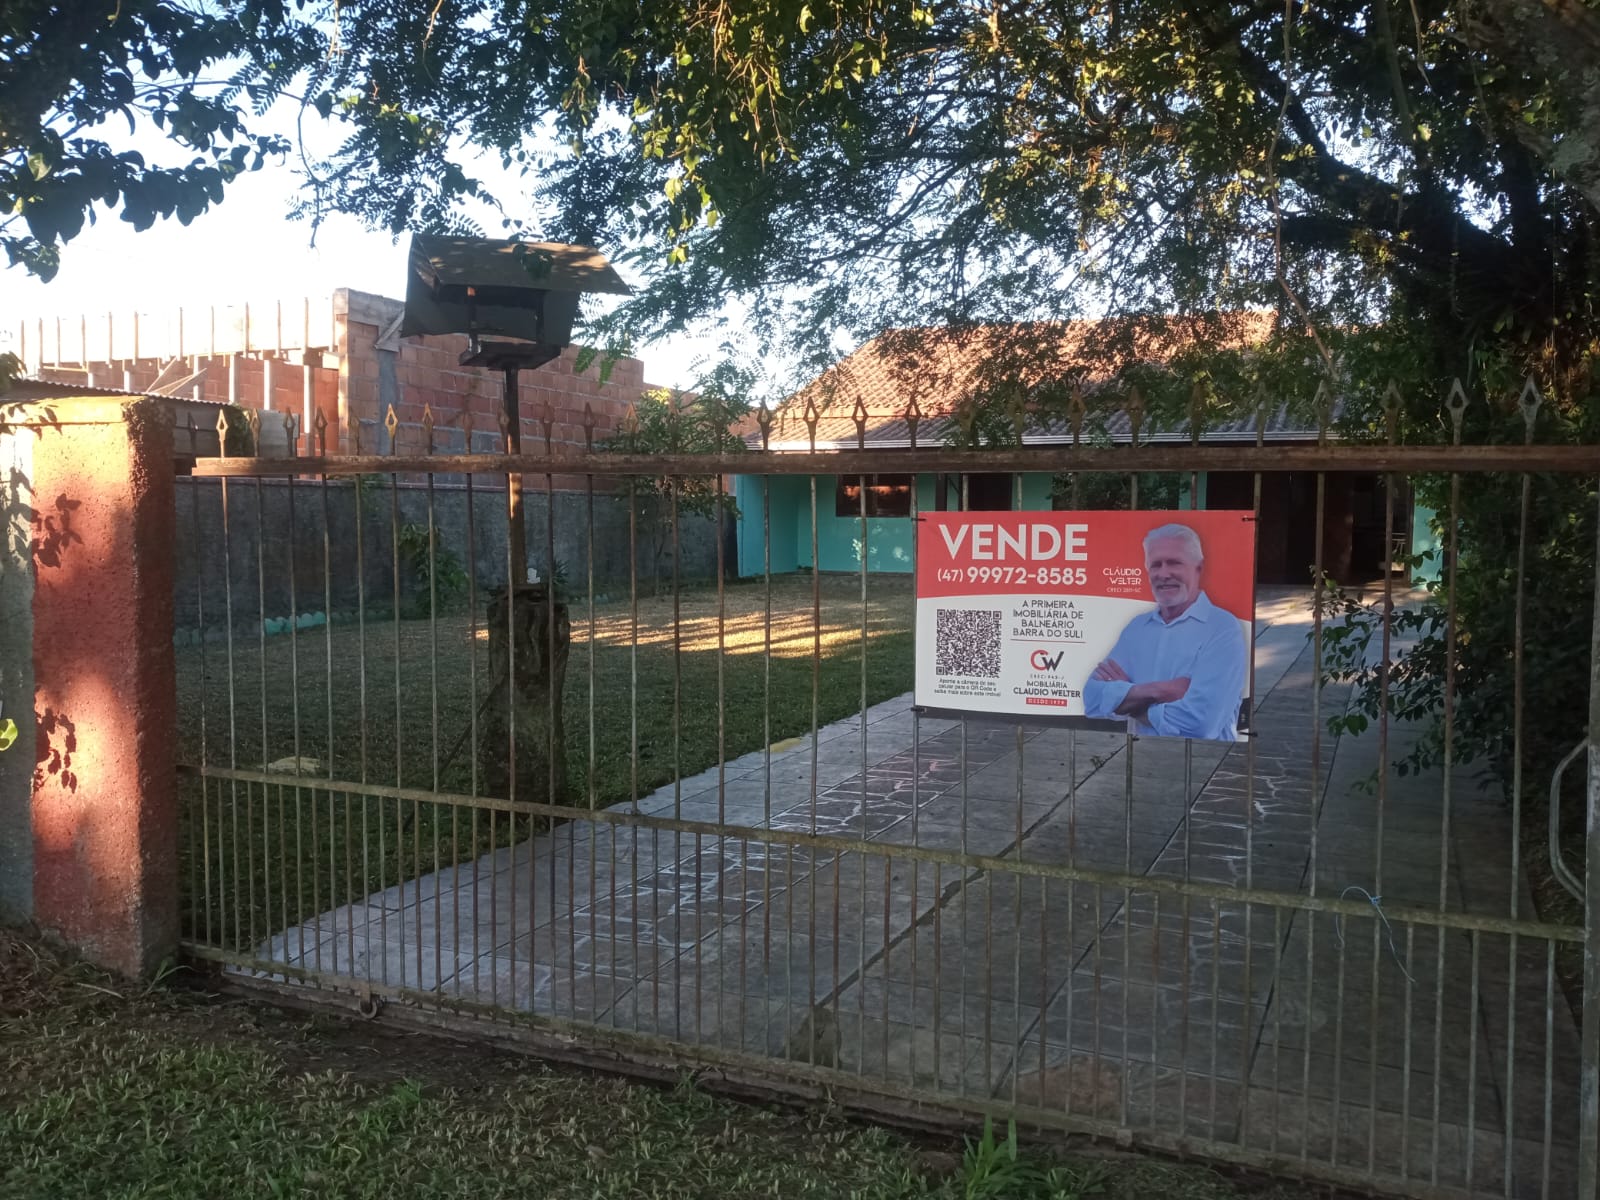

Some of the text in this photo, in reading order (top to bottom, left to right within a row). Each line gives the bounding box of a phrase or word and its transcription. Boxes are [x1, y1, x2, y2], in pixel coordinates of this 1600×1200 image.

[938, 524, 1088, 561] VENDE
[937, 566, 1087, 585] (47) 99972-8585
[1102, 566, 1142, 576] CLÁUDIO
[1109, 577, 1142, 585] WELTER
[1022, 600, 1075, 609] A PRIMEIRA
[1013, 608, 1084, 619] IMOBILIÁRIA DE
[1021, 619, 1075, 629] BALNEÁRIO
[1012, 628, 1045, 637] BARRA
[1047, 629, 1062, 638] DO
[1051, 689, 1081, 698] WELTER
